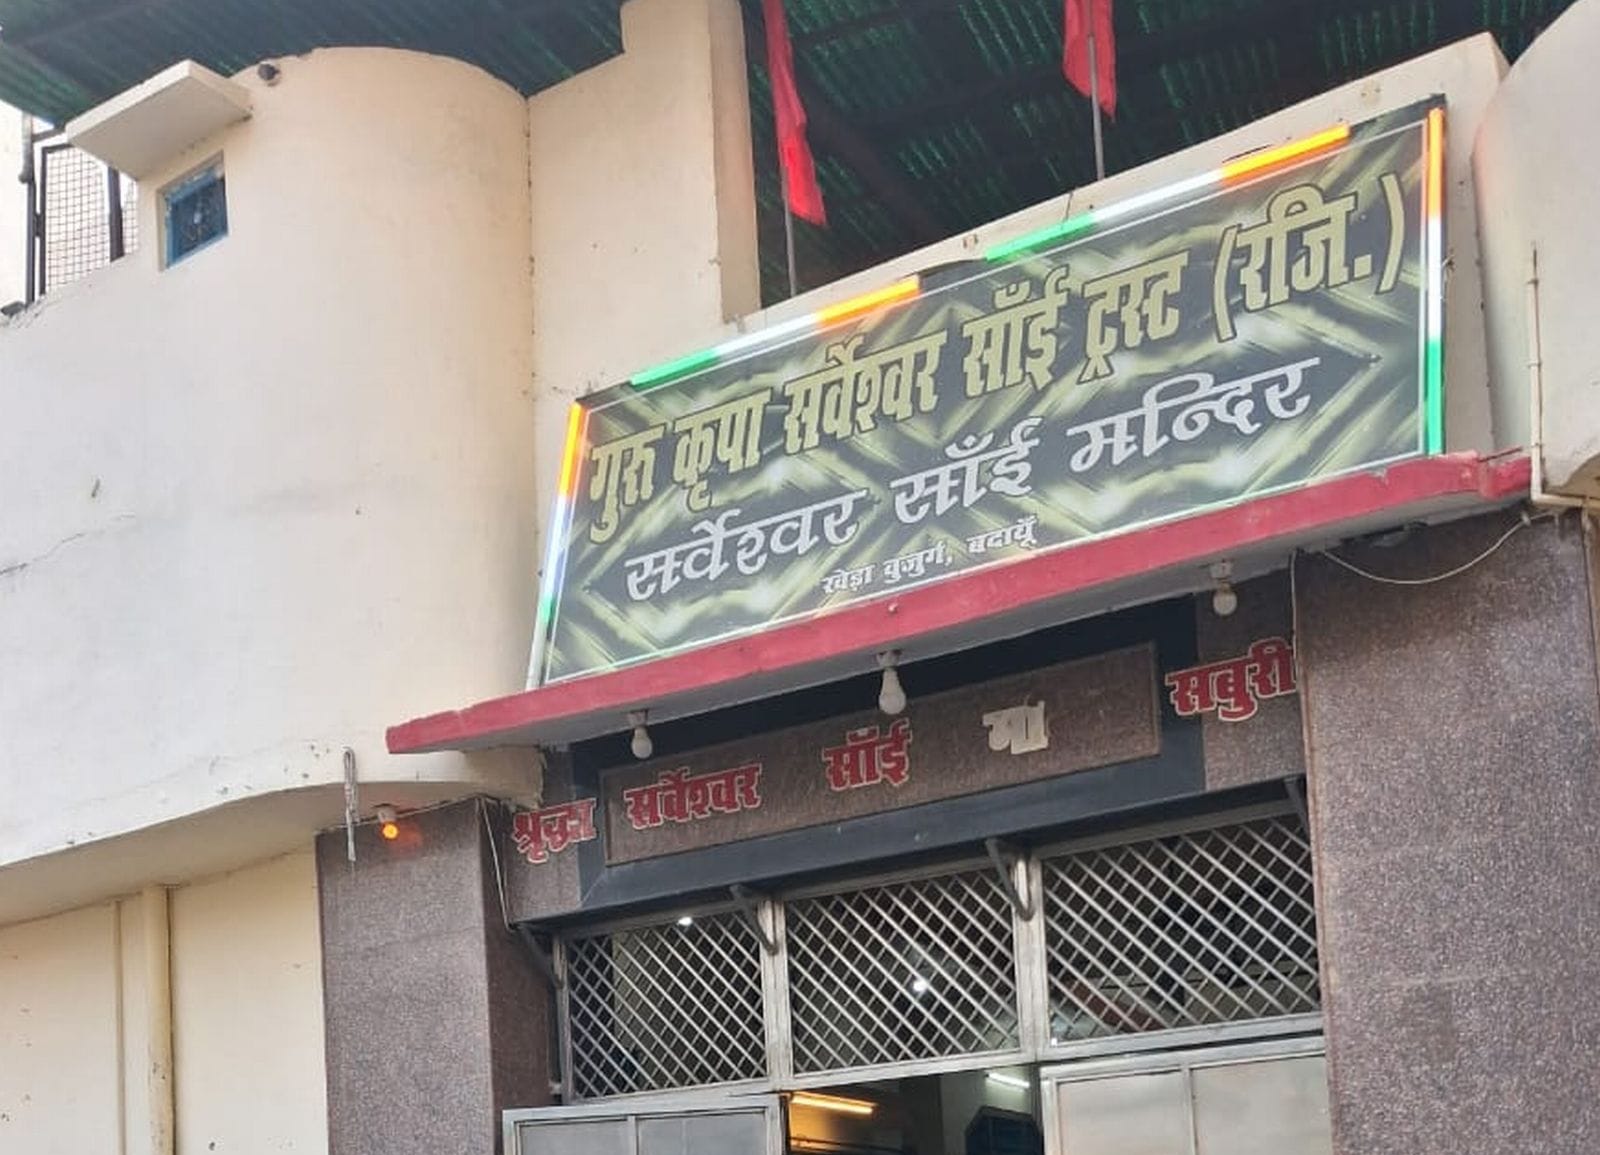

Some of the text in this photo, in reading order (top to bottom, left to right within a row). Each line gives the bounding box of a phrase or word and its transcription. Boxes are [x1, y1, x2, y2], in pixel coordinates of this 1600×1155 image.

[671, 388, 771, 512] कृपा
[783, 330, 947, 454] सर्वेश्वर
[1078, 250, 1190, 384] ट्रस्ट
[625, 488, 868, 602] सर्वेश्वर
[1066, 357, 1320, 473] मन्दिर
[1165, 636, 1298, 722] सबुरी
[623, 763, 763, 830] सर्वेश्वर
